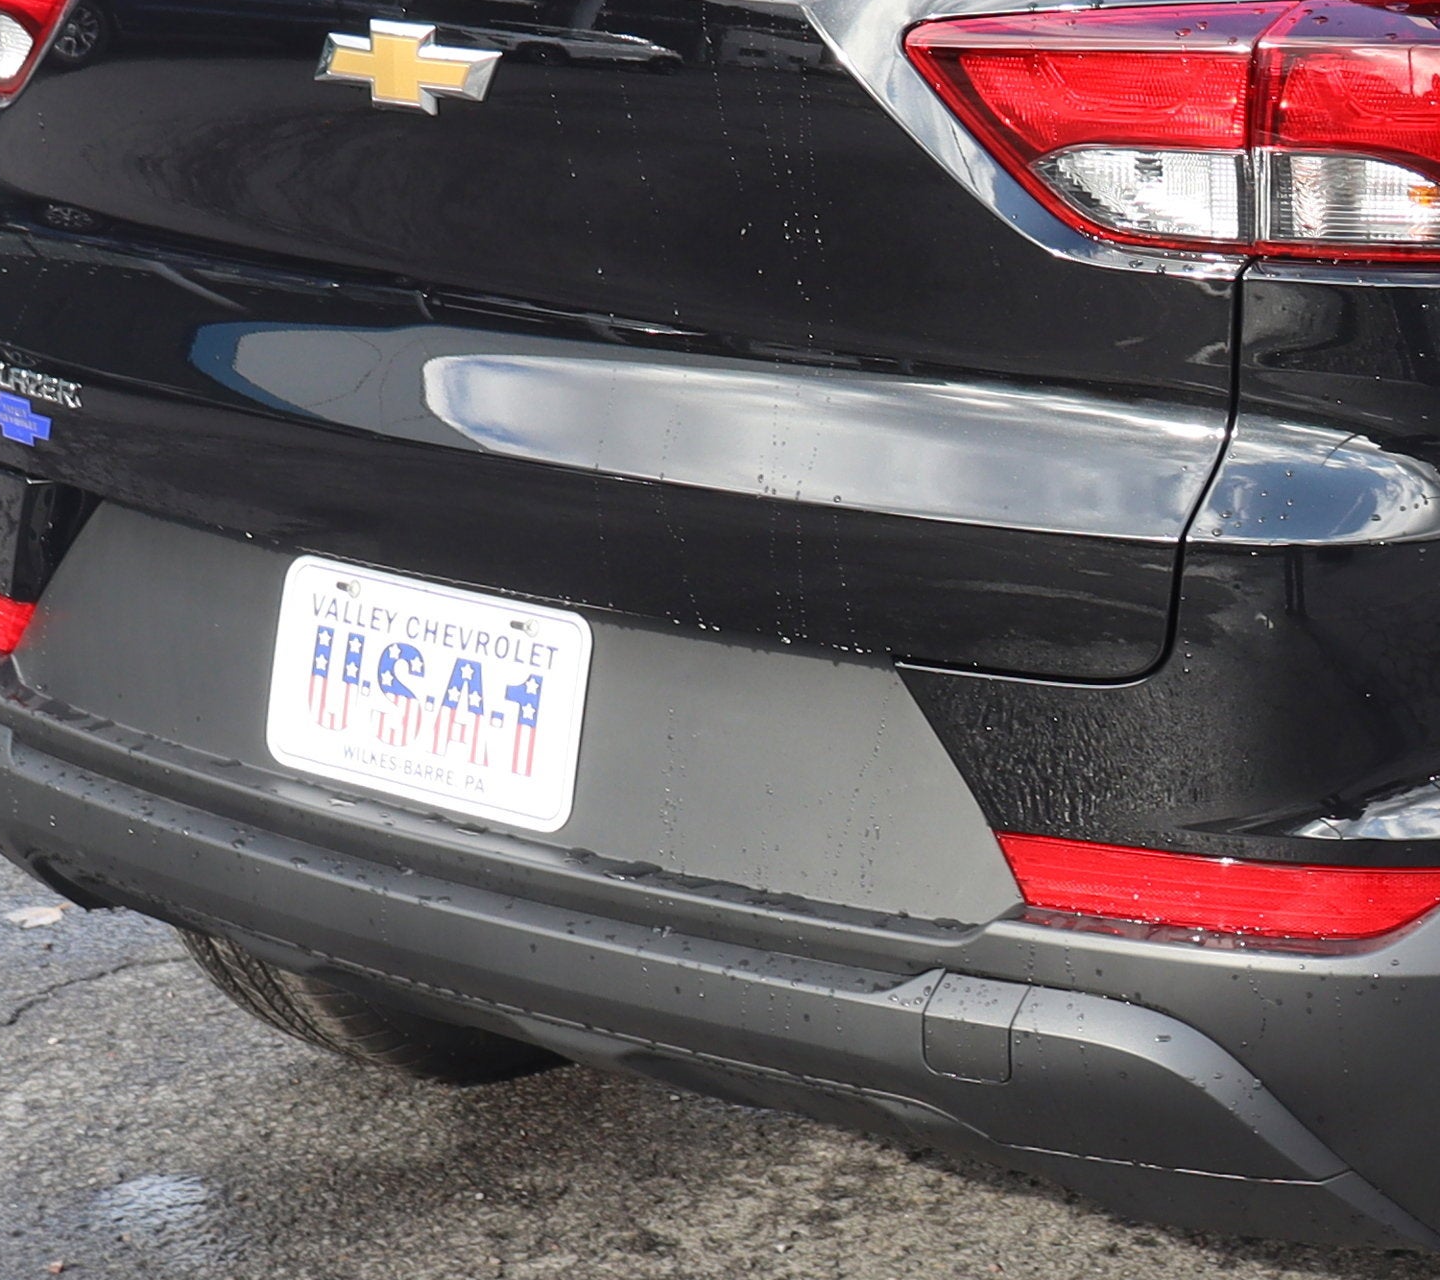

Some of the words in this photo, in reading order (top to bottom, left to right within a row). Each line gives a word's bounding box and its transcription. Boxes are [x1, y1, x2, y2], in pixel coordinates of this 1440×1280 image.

[312, 593, 398, 634] VALLEY
[405, 615, 559, 670] CHEVROLET
[464, 775, 485, 793] PA
